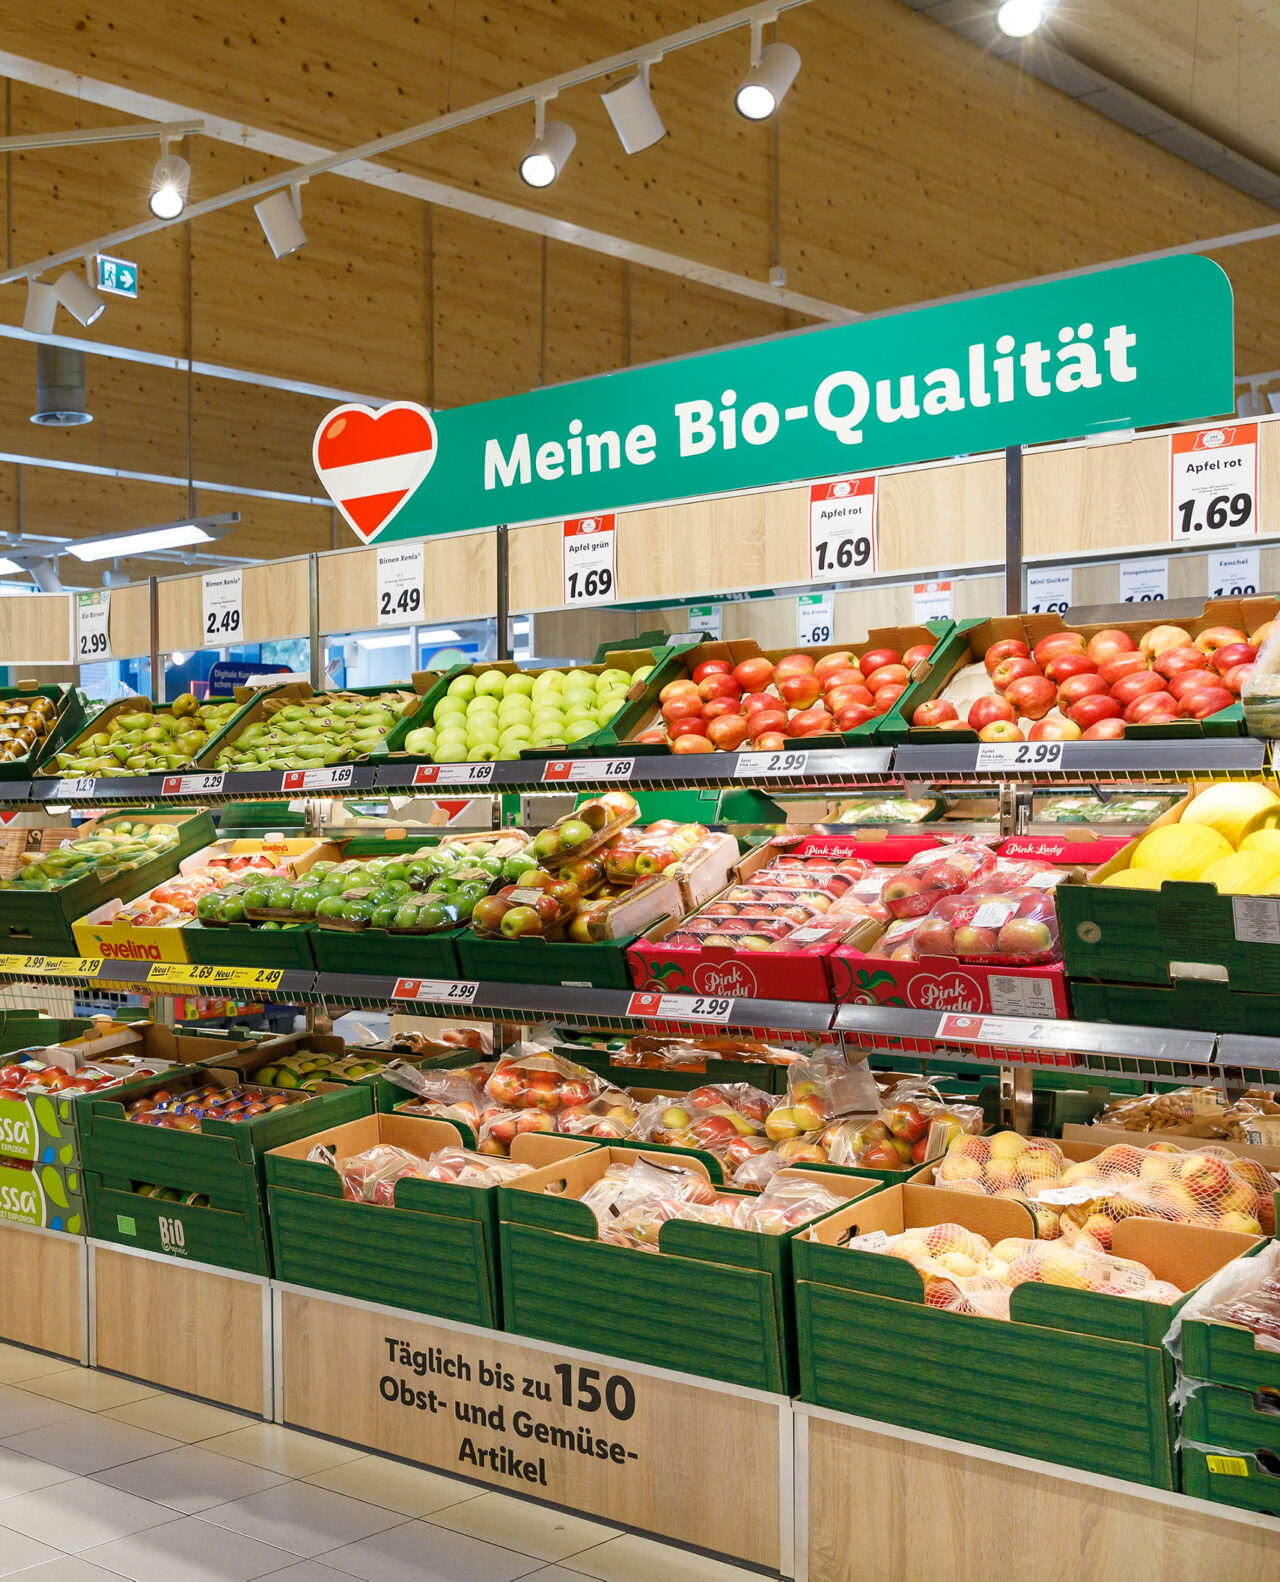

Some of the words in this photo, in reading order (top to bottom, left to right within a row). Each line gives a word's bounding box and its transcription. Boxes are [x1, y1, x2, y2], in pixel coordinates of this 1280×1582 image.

[484, 420, 657, 490] Meine
[675, 323, 1138, 458] Bio-Qualität
[1186, 460, 1221, 475] Apfel
[1223, 458, 1243, 469] rot
[820, 508, 846, 520] Apfel
[848, 506, 862, 516] rot
[1178, 492, 1253, 533] 1.69
[568, 542, 590, 554] Apfel
[591, 540, 609, 551] grün
[815, 536, 872, 571] 1.69
[378, 557, 398, 566] Birnen
[568, 568, 613, 598] 1.69
[380, 588, 420, 615] 2.49
[206, 609, 240, 634] 2.49
[800, 625, 830, 643] -.69
[81, 633, 107, 655] 2.99
[1014, 743, 1061, 764] 2.99
[605, 761, 632, 776] 1.69
[767, 754, 806, 771] 2.99
[202, 775, 222, 788] 2.29
[331, 769, 352, 783] 1.69
[468, 766, 492, 780] 1.69
[805, 844, 829, 857] Pink
[830, 845, 855, 858] Lady
[1005, 843, 1034, 856] Pink
[1035, 843, 1064, 857] Lady
[99, 939, 162, 961] evelina
[23, 956, 45, 969] 2.99
[44, 960, 62, 970] Neu!
[78, 959, 100, 972] 2.19
[151, 965, 171, 976] Neu!
[189, 965, 214, 979] 2.69
[214, 970, 235, 980] Neu!
[254, 970, 281, 983] 2.49
[704, 966, 744, 993] Pink
[447, 984, 476, 999] 2.99
[920, 978, 968, 1006] Pink
[691, 997, 730, 1016] 2.99
[1, 1142, 29, 1156] EXPLOSION
[8, 1211, 36, 1225] EXPLOSION
[384, 1337, 471, 1382] Täglich
[478, 1359, 515, 1393] bis
[522, 1377, 553, 1402] zu
[554, 1362, 636, 1421] 150
[379, 1375, 448, 1414] Obst-
[454, 1400, 506, 1432] und
[512, 1410, 639, 1464] Gemüse-
[458, 1437, 548, 1487] Artikel
